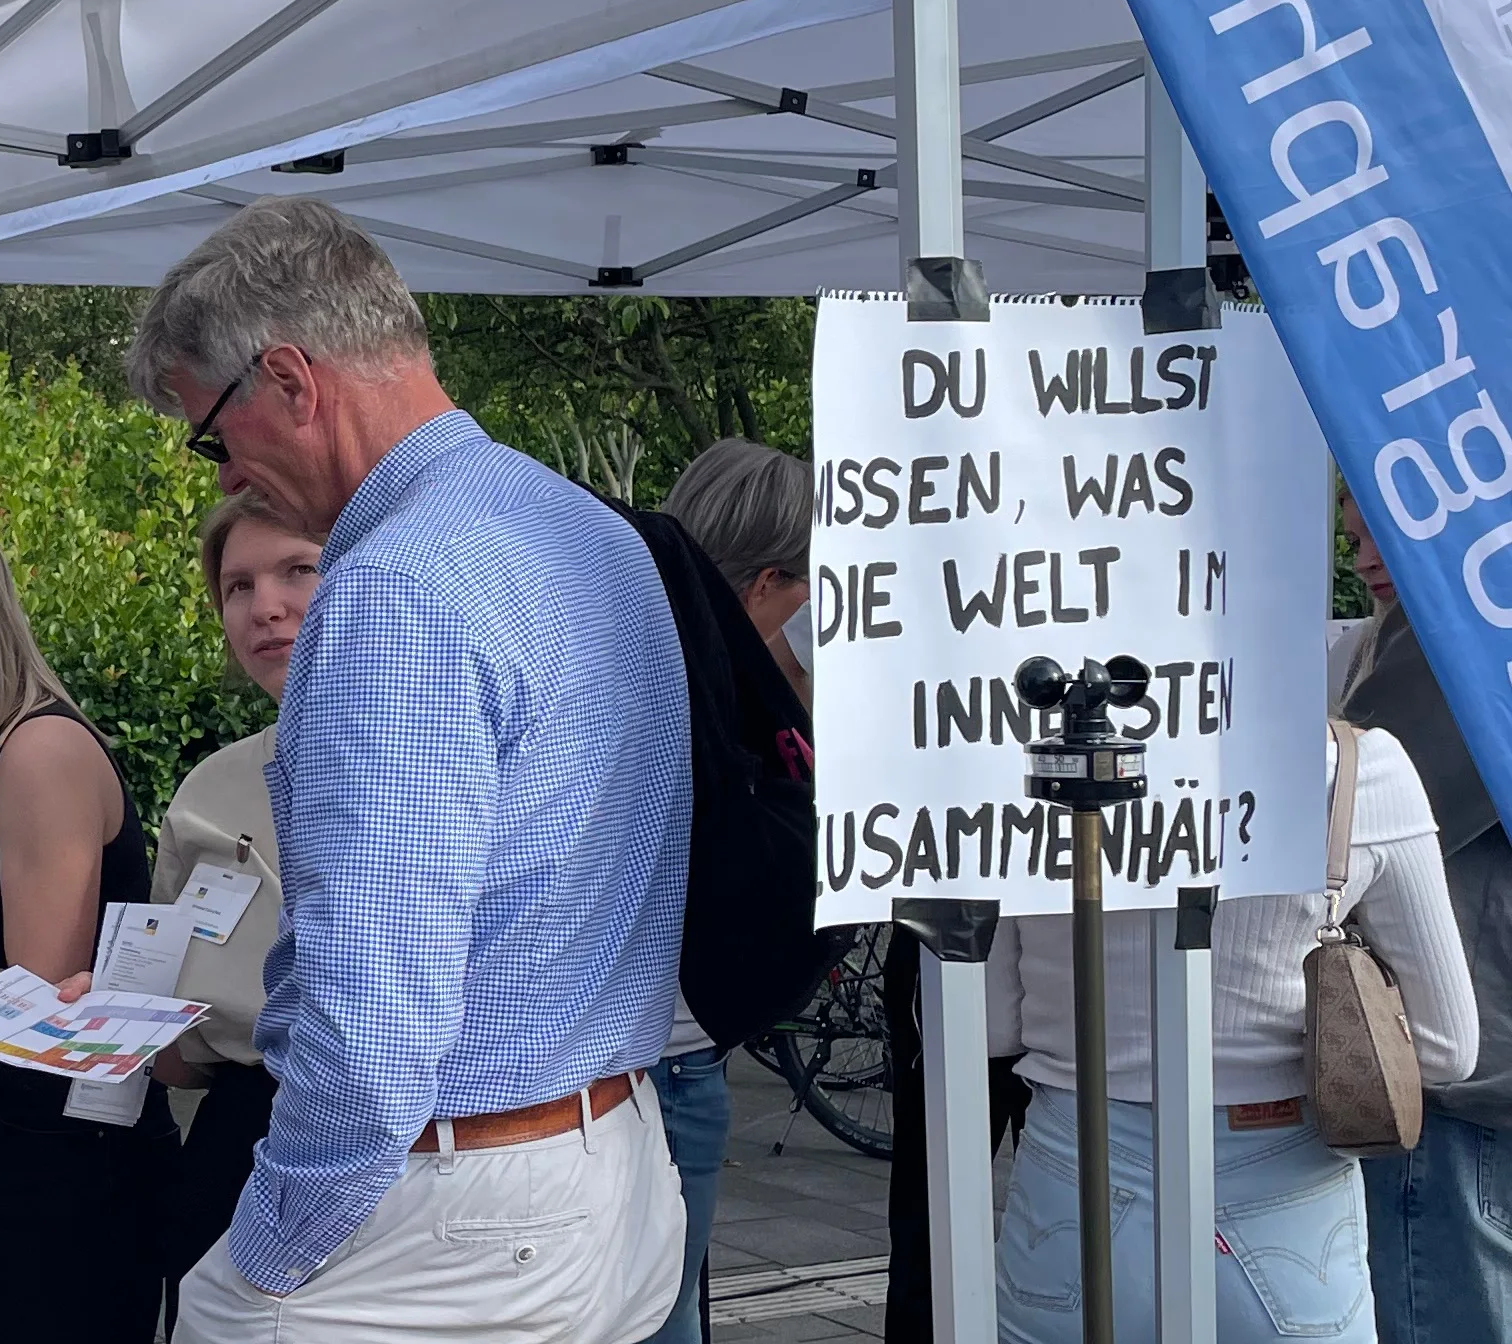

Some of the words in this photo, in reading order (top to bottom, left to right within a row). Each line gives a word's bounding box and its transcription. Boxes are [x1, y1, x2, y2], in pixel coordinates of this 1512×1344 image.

[902, 348, 985, 419] DU
[1028, 344, 1217, 417] WILLST
[1063, 447, 1193, 521] WAS
[817, 561, 903, 647] DIE
[942, 547, 1121, 634] WELT
[815, 778, 1256, 892] USAMMENHÄLT?
